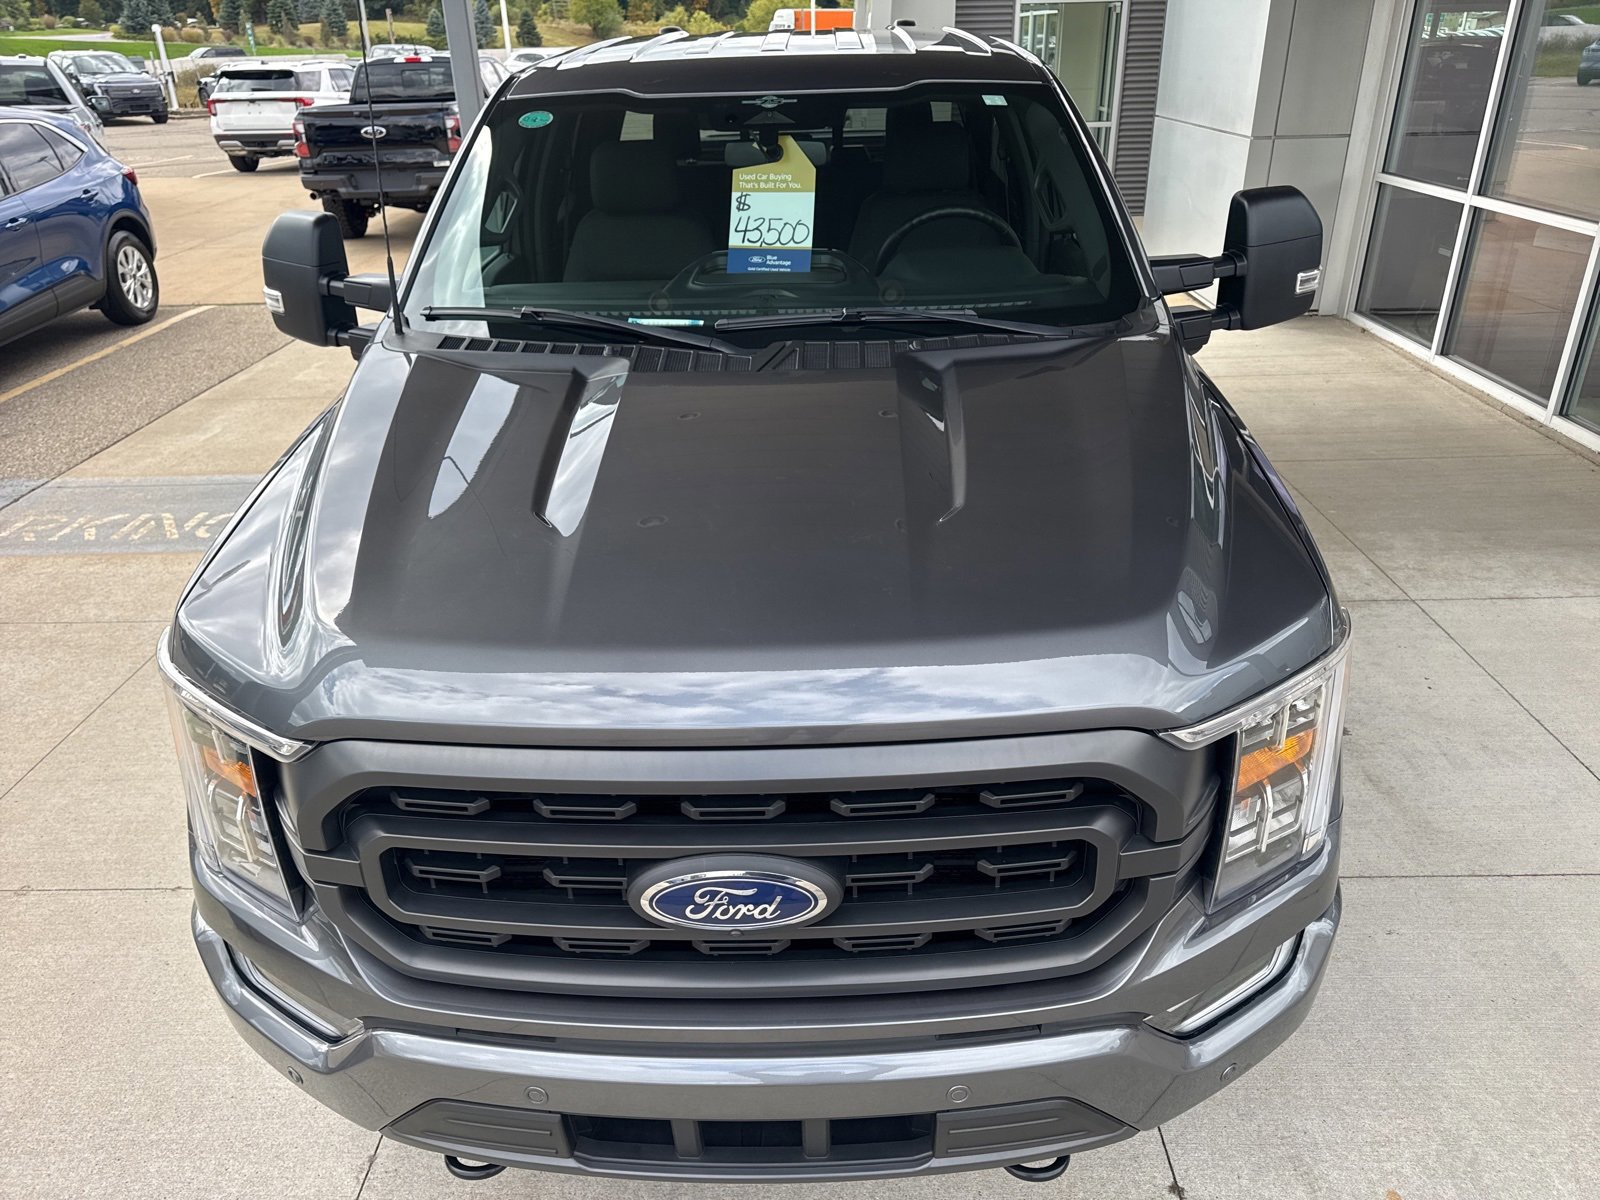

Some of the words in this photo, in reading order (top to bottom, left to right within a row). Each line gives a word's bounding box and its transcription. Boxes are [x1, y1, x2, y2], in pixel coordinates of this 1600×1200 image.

[735, 192, 751, 212] $
[734, 215, 810, 247] 43,500
[684, 886, 783, 920] Ford
